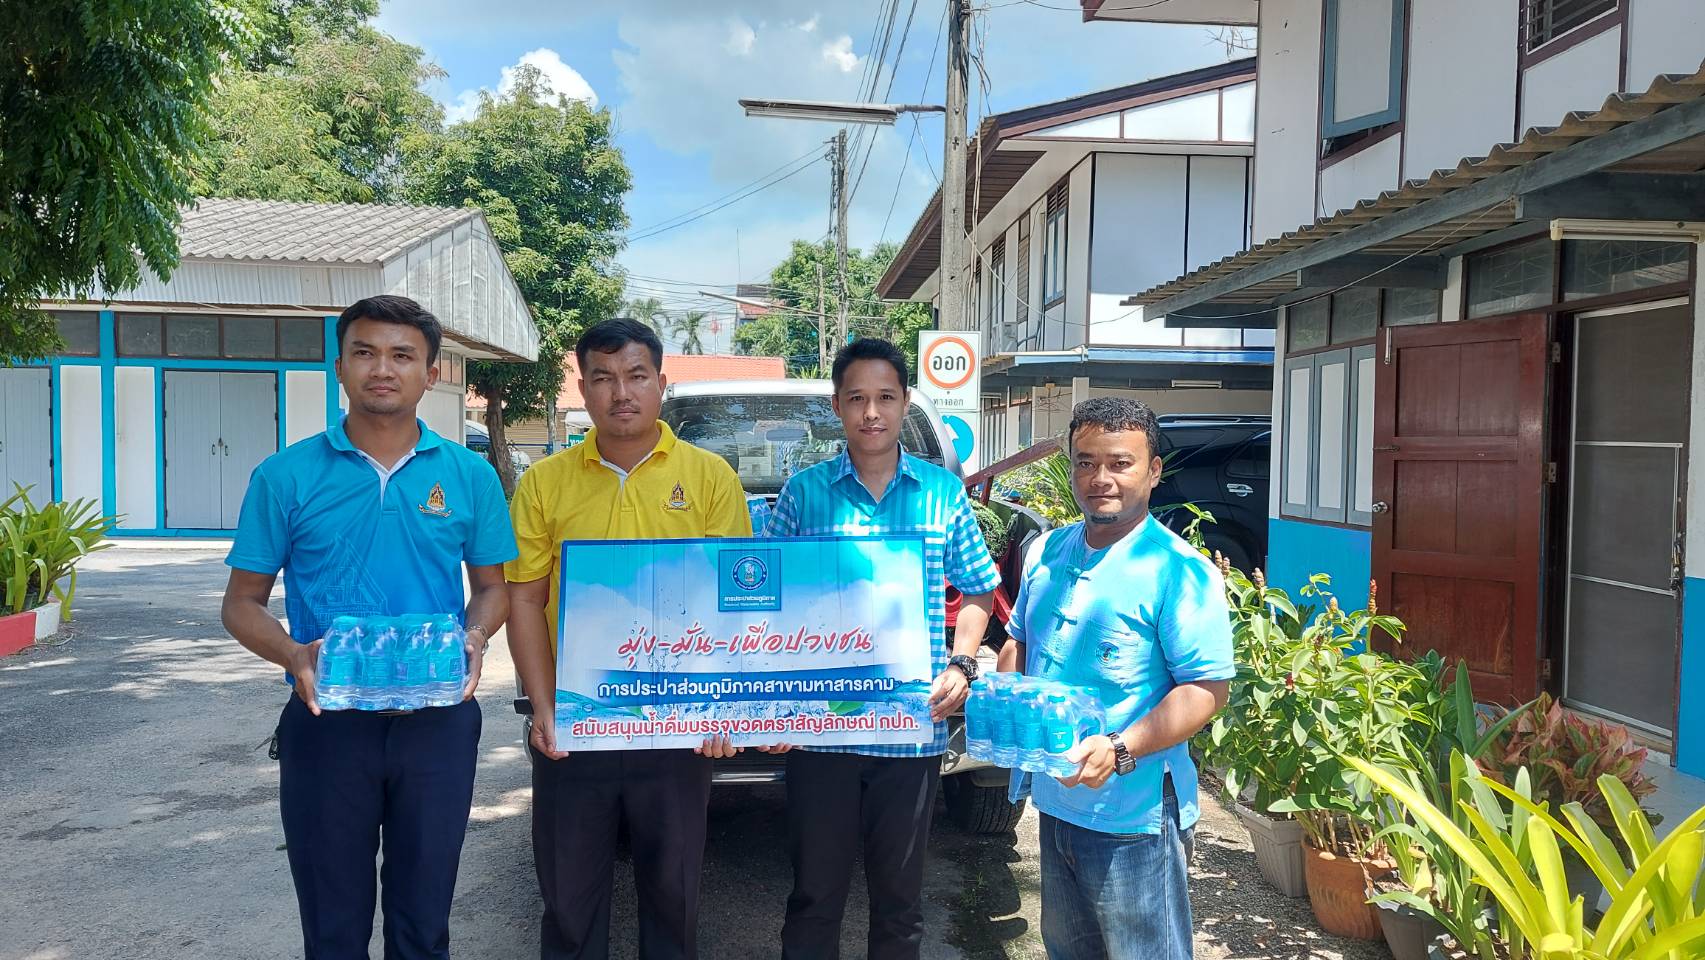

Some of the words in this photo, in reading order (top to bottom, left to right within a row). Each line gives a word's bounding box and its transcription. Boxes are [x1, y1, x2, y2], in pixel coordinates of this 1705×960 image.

[932, 355, 966, 371] ออก
[599, 678, 894, 699] การประปาส่วนภูมิภาคสาขามหาสารคาม
[573, 711, 874, 740] สนับสนุนน้ำดื่มบรรจุขวดตราสัญลักษณ์
[880, 712, 919, 730] กปภ.
